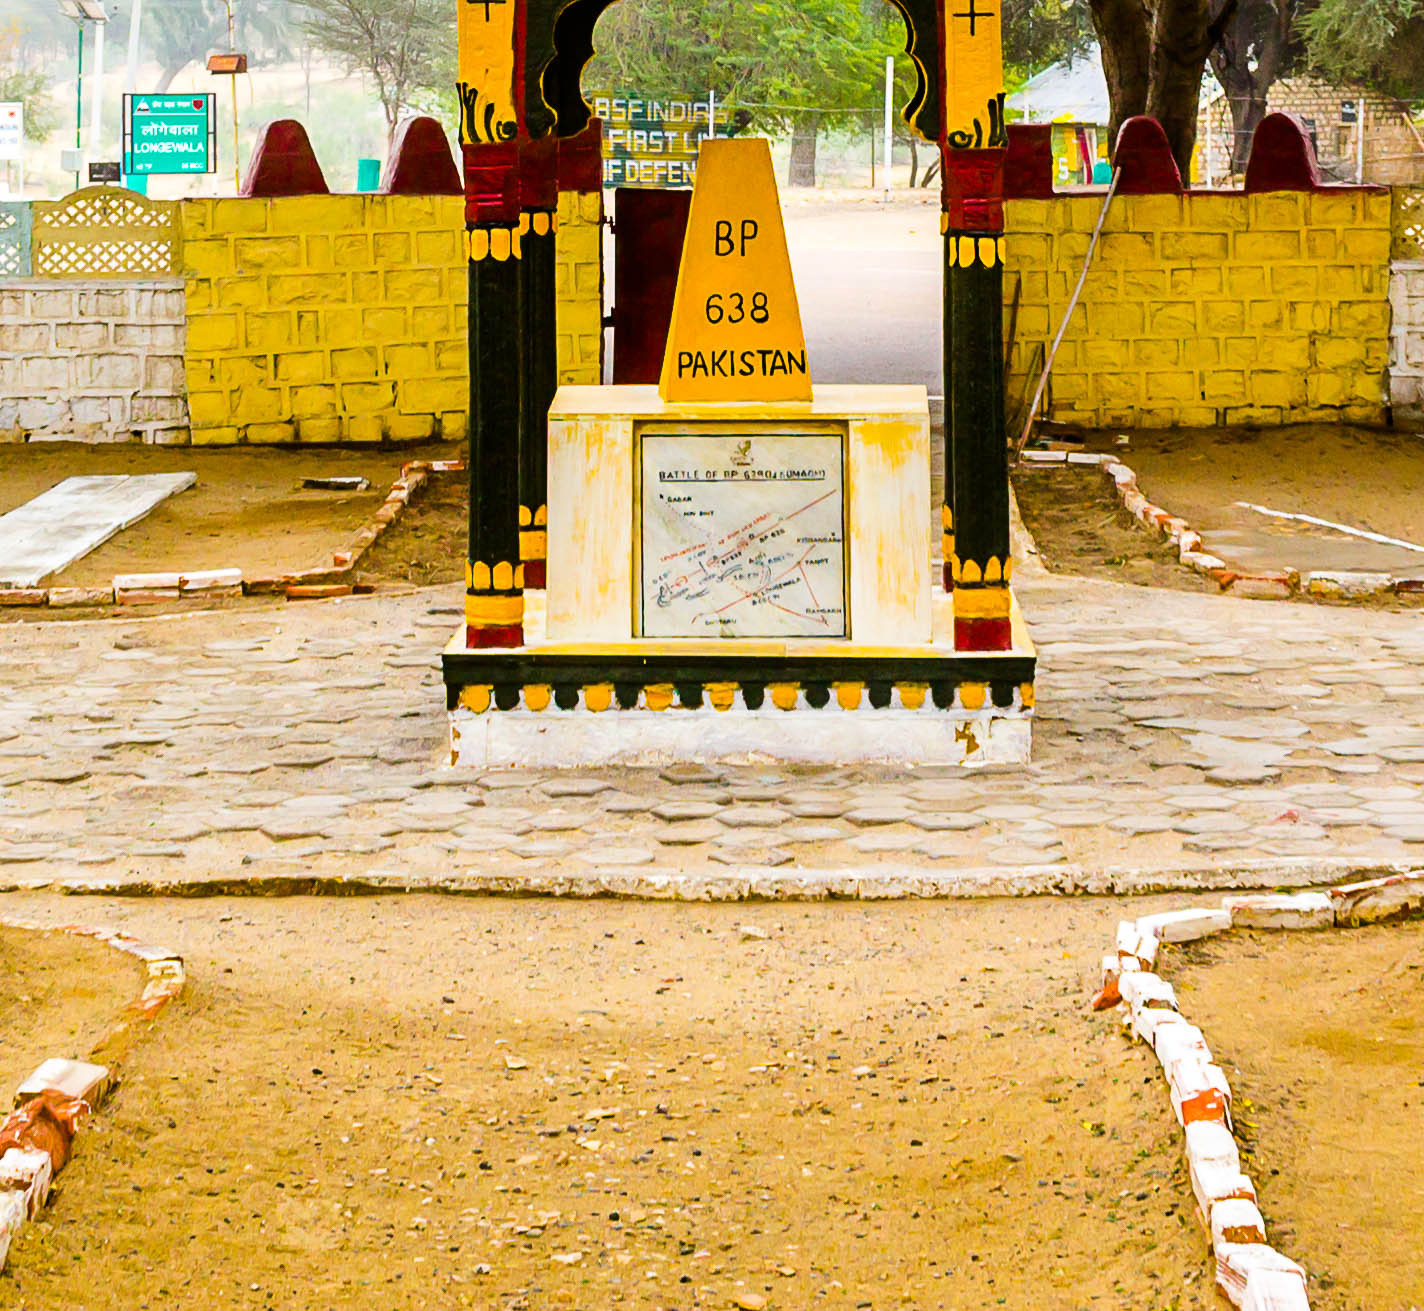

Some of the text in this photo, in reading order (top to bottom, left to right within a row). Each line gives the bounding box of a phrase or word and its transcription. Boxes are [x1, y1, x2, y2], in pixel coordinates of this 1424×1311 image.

[595, 97, 643, 121] BSF
[133, 142, 205, 154] LONGEWALA
[608, 129, 679, 153] FIRST
[625, 159, 697, 183] DEFEN
[715, 220, 758, 257] BP
[706, 292, 769, 324] 638
[678, 349, 806, 379] PAKISTAN
[659, 470, 698, 480] BATTLE
[705, 470, 718, 480] OF
